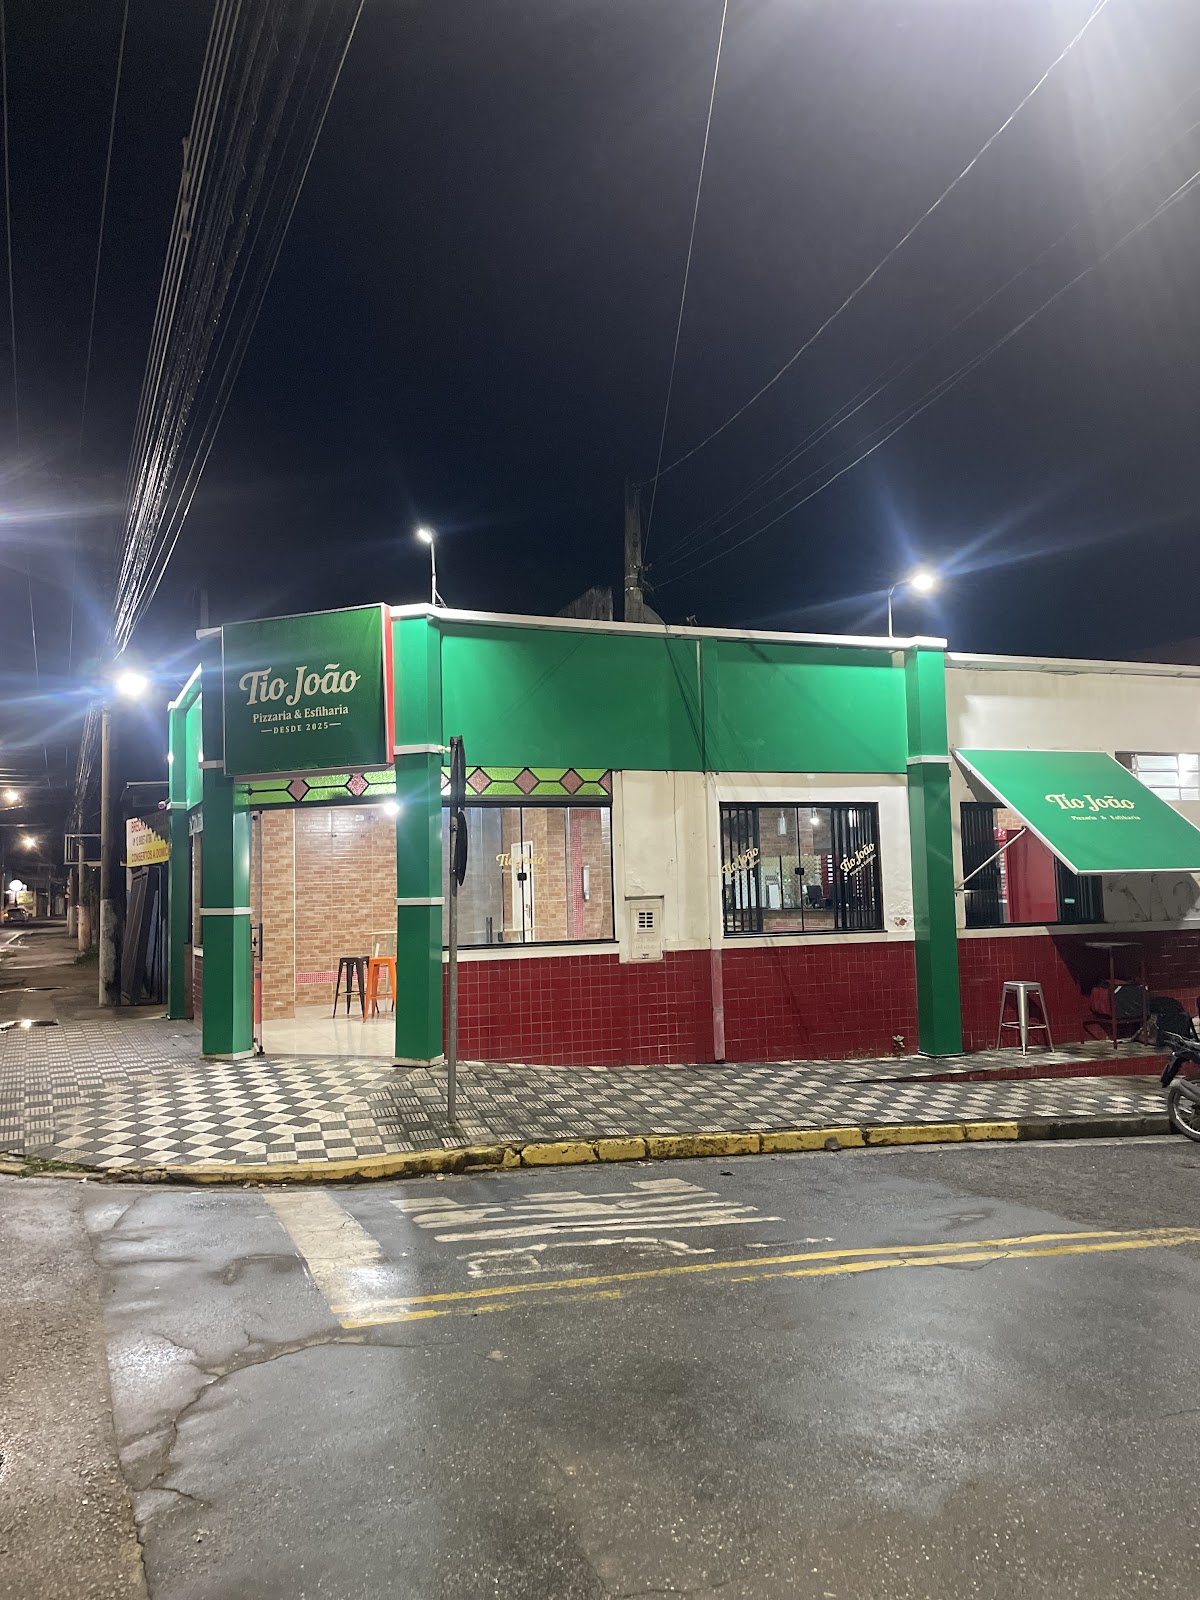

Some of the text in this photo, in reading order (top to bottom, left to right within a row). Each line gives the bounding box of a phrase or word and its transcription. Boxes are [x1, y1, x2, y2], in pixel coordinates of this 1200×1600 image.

[239, 663, 361, 706] Tio João
[252, 704, 349, 723] Pizzaria & Esfiharia
[273, 722, 330, 735] DESDE 2025
[1044, 793, 1135, 812] Tio João
[495, 852, 514, 866] Tio
[840, 856, 856, 873] Tio
[854, 843, 875, 866] João
